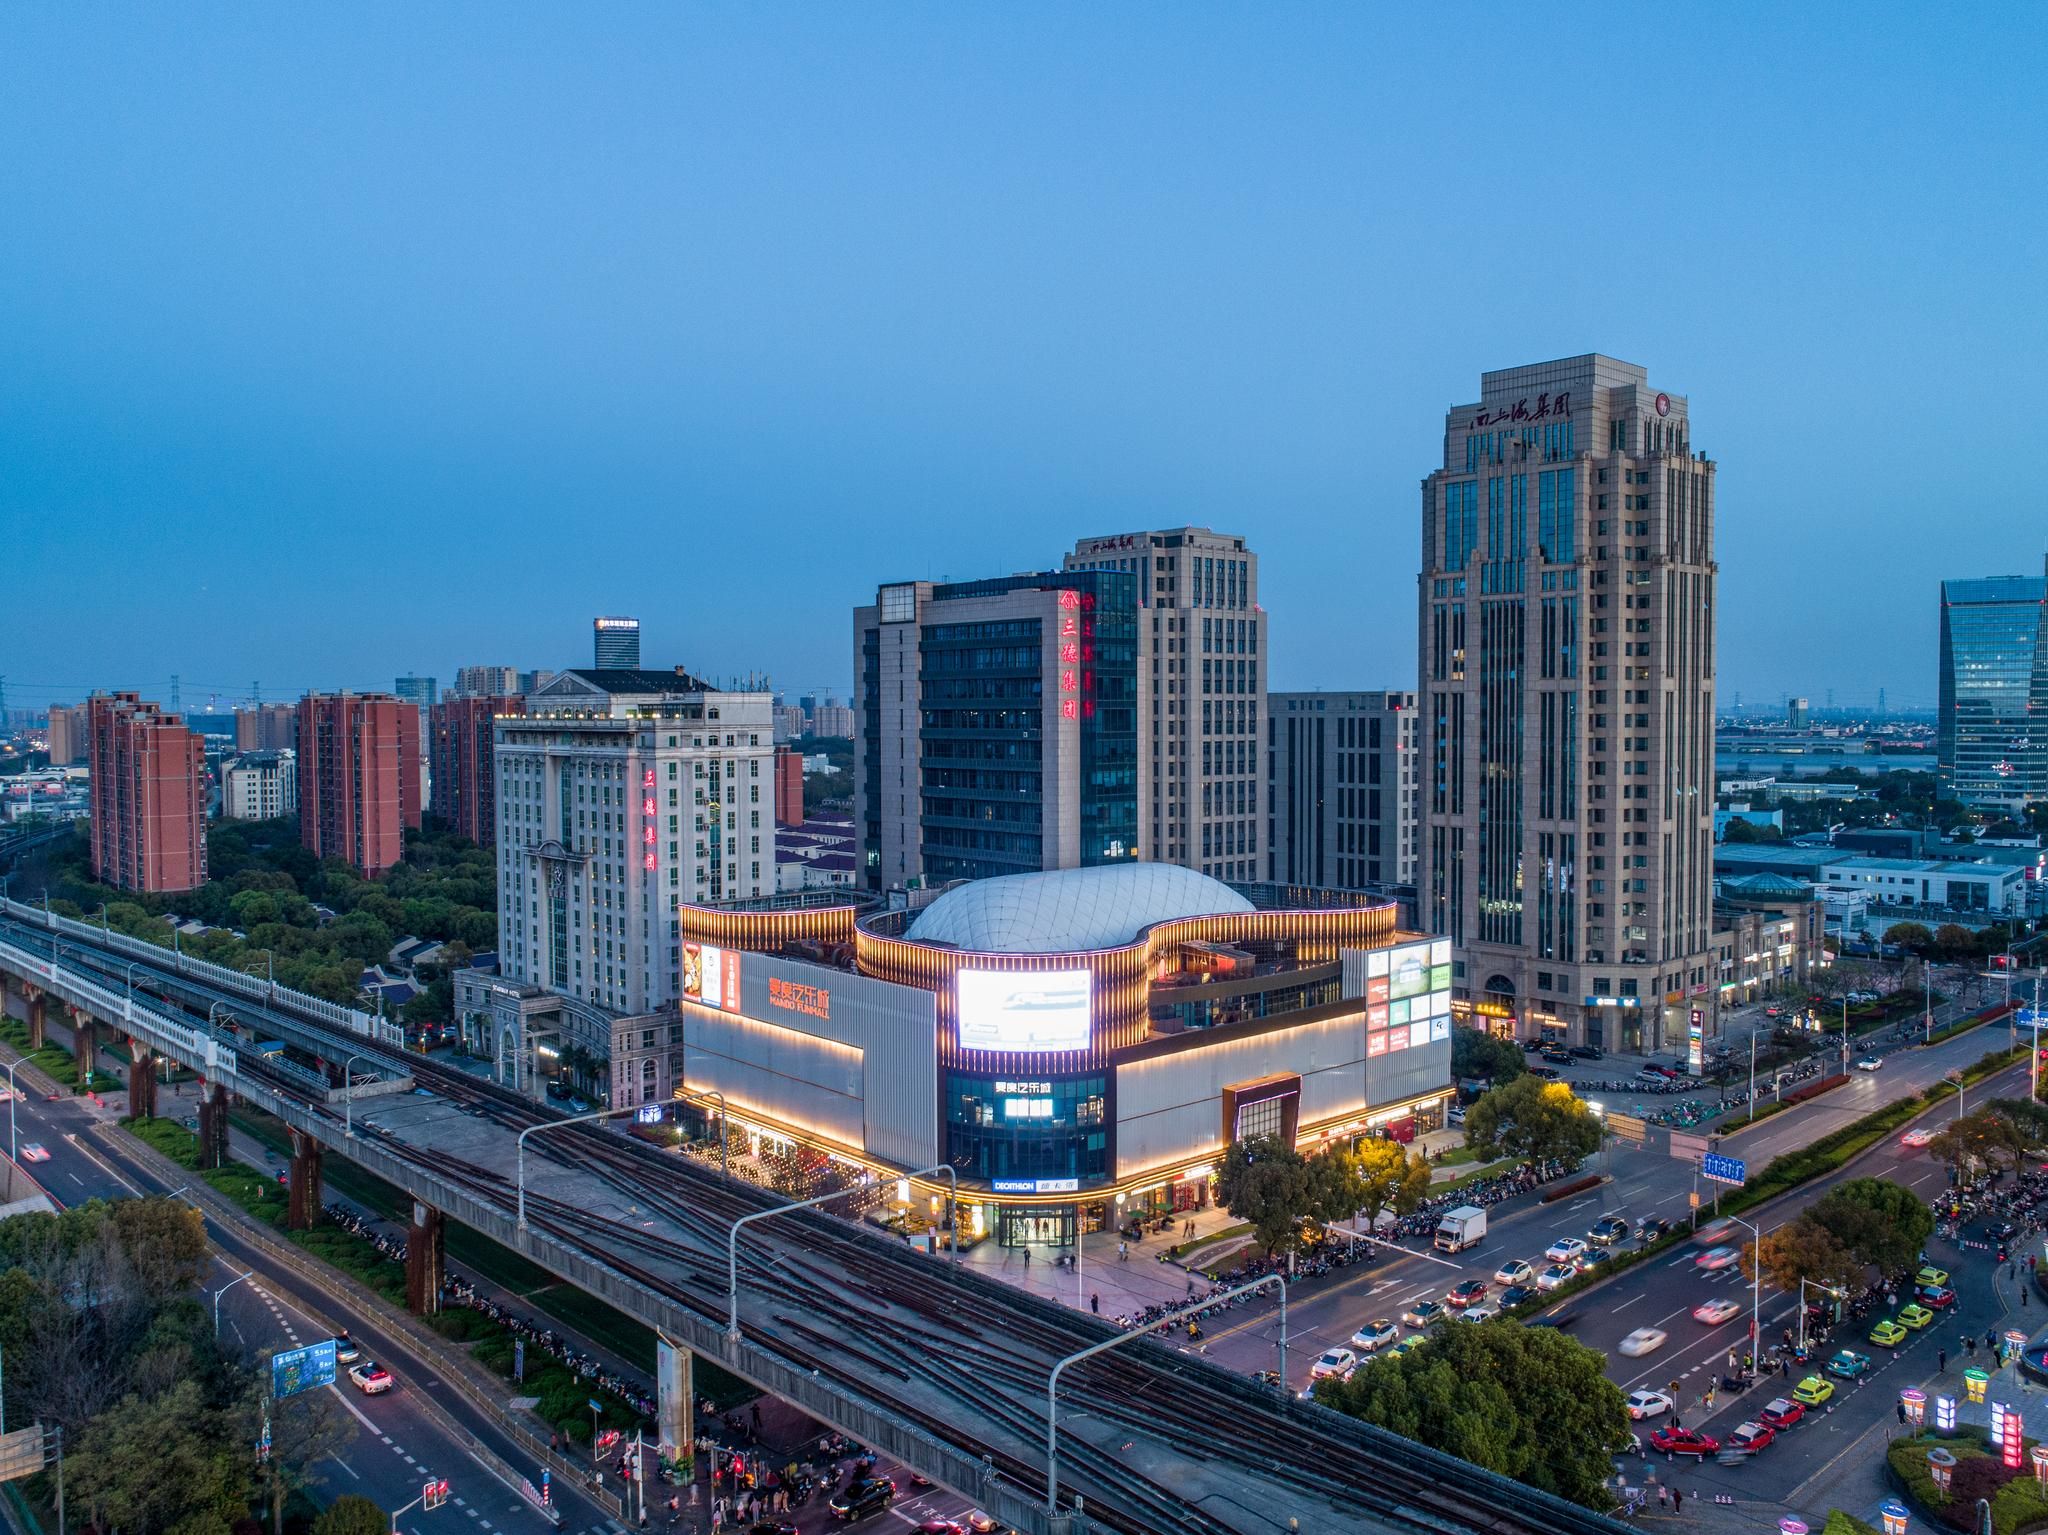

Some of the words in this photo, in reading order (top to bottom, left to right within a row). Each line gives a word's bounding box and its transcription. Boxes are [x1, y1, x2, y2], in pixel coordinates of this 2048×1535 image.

[1062, 619, 1078, 719] 三德集团
[644, 769, 656, 870] 三德集团
